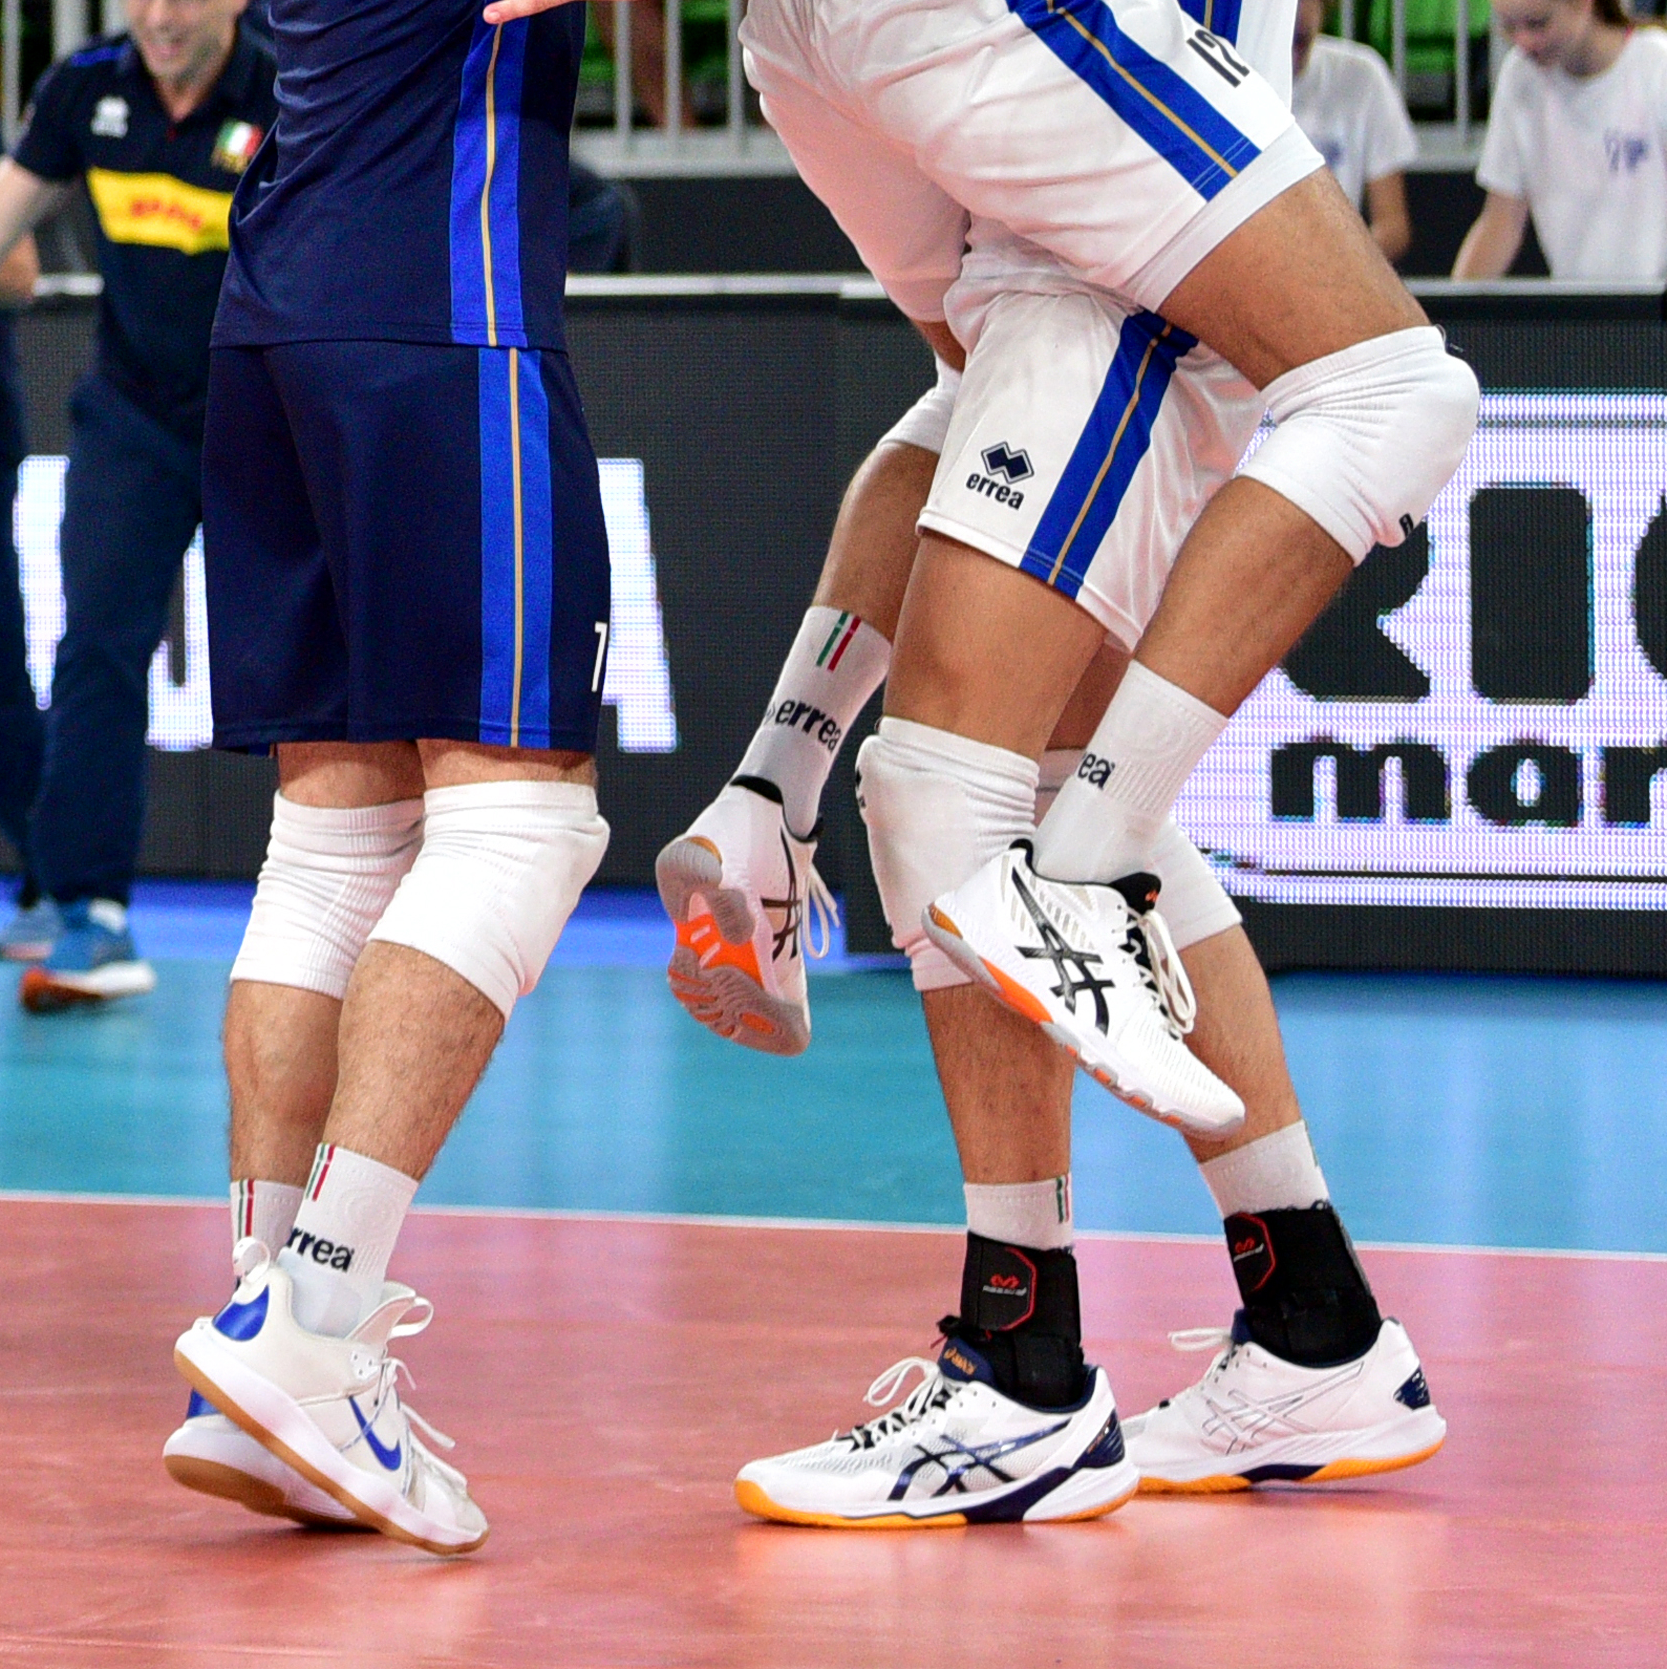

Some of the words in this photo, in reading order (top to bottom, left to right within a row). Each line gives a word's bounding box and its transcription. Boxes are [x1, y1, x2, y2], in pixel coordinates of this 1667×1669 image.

[1185, 28, 1251, 90] 12
[965, 472, 1025, 512] errea
[286, 1225, 355, 1273] rrea
